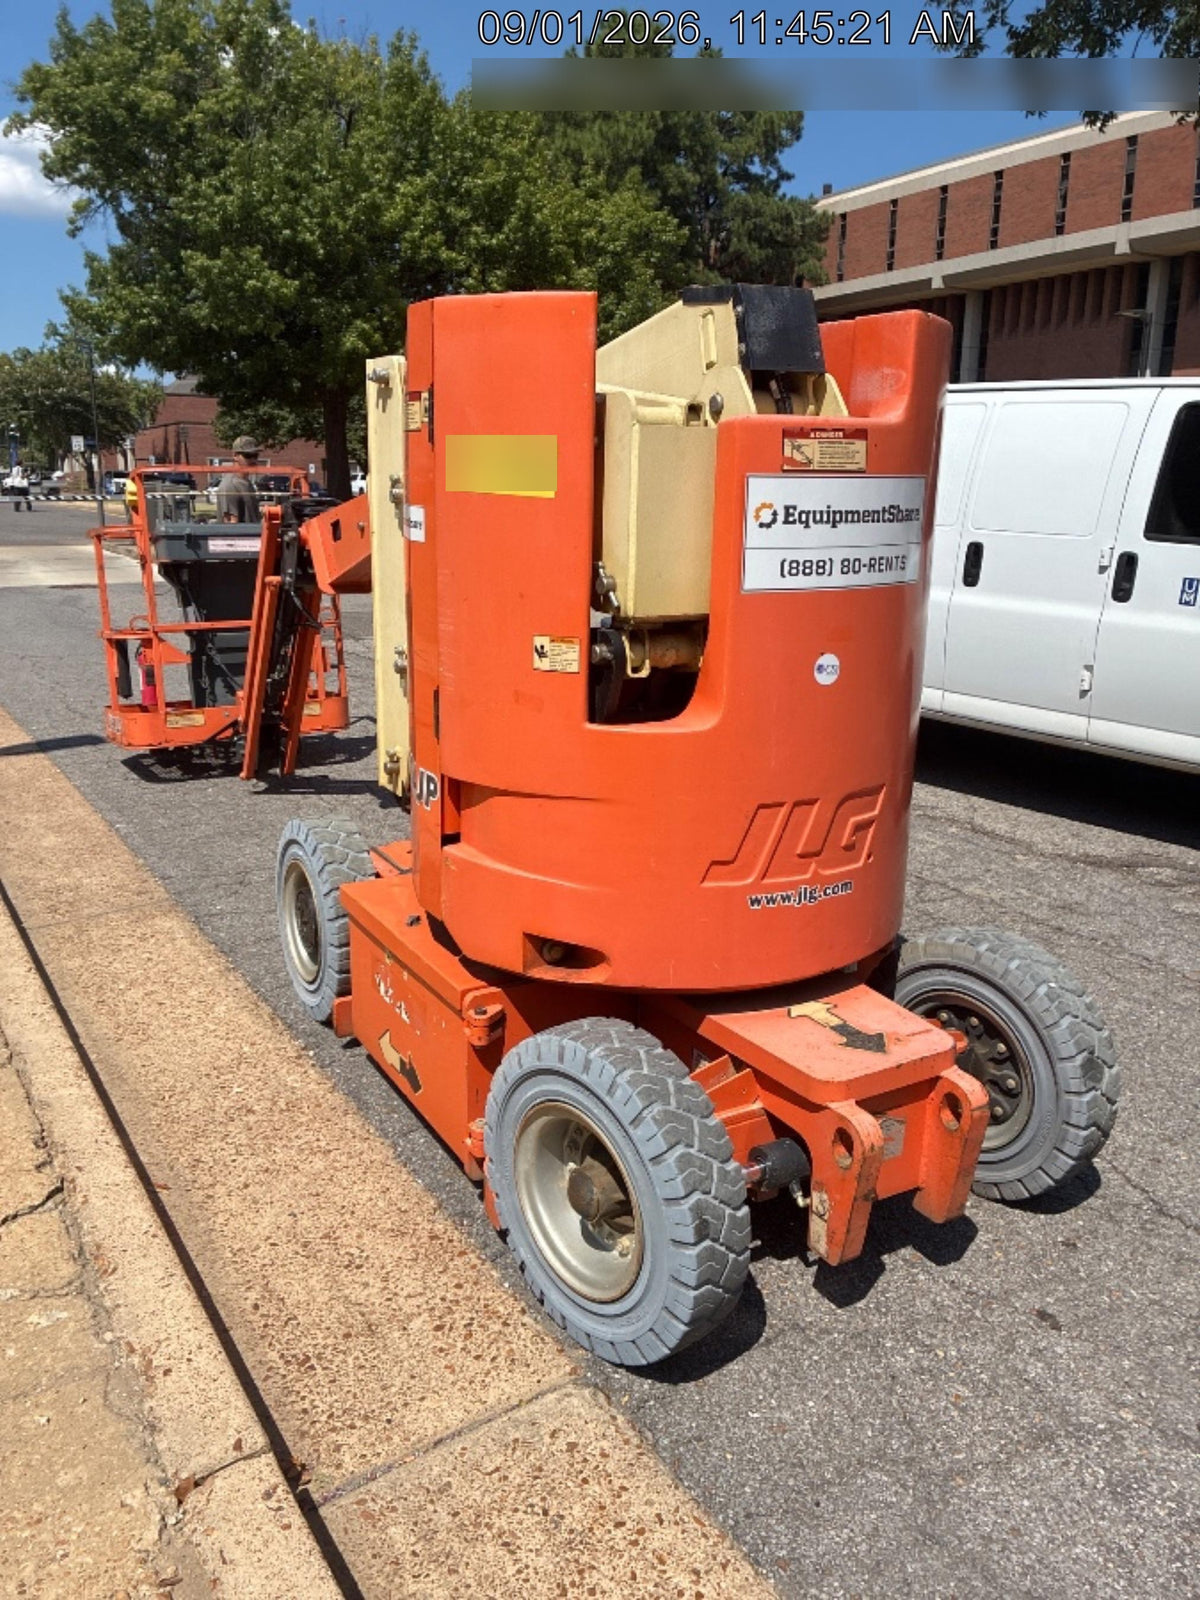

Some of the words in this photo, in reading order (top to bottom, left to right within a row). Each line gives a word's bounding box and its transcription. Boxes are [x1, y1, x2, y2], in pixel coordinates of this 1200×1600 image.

[781, 504, 920, 529] EquipmentShare
[780, 557, 833, 578] (888)
[840, 554, 907, 575] 80-RENTS
[700, 783, 886, 888] JLG
[748, 880, 853, 910] www.jlg.com
